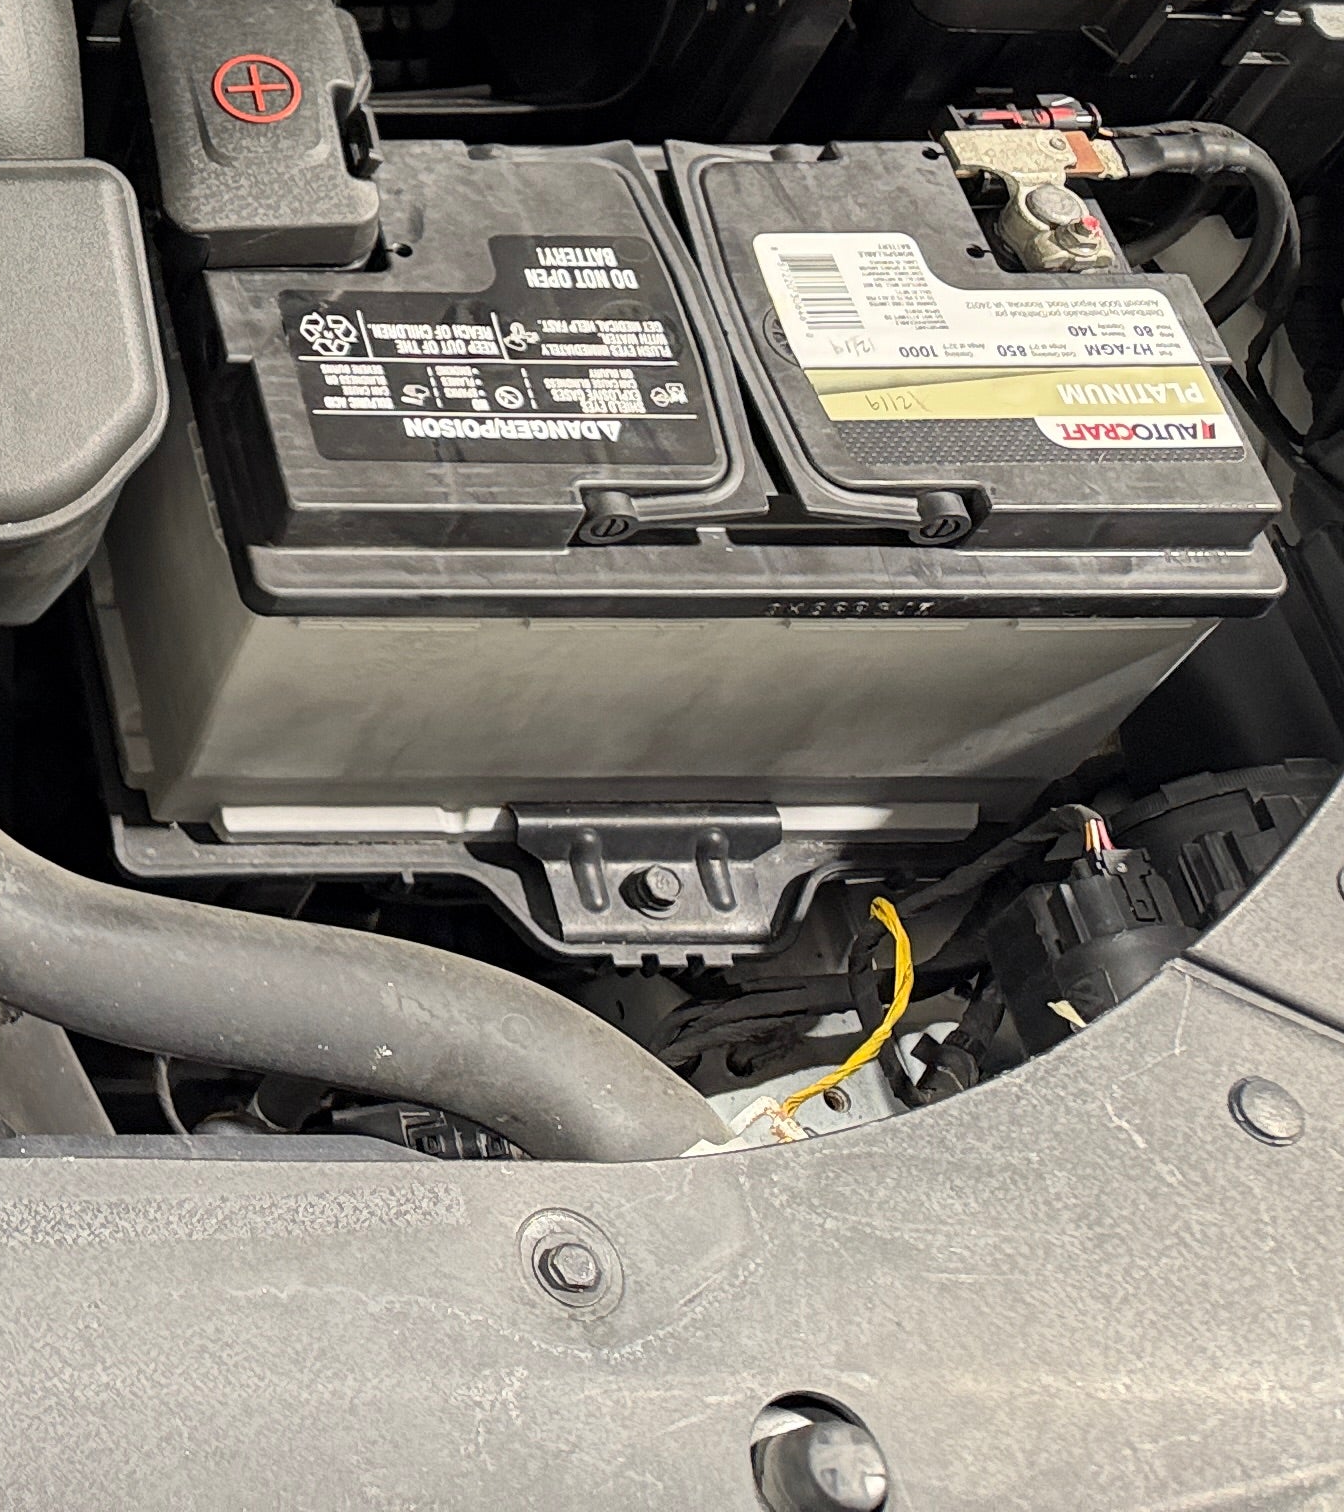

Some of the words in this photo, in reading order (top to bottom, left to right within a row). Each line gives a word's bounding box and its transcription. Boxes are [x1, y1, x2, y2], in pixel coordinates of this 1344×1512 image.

[535, 247, 618, 267] BATTERY!
[524, 268, 572, 289] OPEN
[572, 268, 610, 289] NOT
[609, 268, 638, 289] DO
[366, 323, 433, 340] CHILDREN.
[433, 324, 452, 340] OF
[451, 324, 495, 340] REACH
[536, 319, 567, 333] FAST.
[568, 320, 596, 333] HELP
[595, 320, 642, 333] MEDICAL
[641, 320, 664, 333] GET
[1067, 325, 1097, 337] 140
[1133, 324, 1153, 337] 80
[394, 339, 419, 354] THE
[638, 333, 669, 345] WITH
[421, 340, 439, 354] OF
[439, 340, 467, 355] OUT
[467, 340, 500, 355] KEEP
[609, 344, 636, 357] EYES
[898, 345, 938, 358] 1000
[996, 344, 1027, 357] 850
[1084, 343, 1154, 357] H7-AGM
[1055, 382, 1203, 406] PLATINUM
[402, 418, 601, 440] DANGER/POISON
[1060, 422, 1198, 441] AUTOCRAFT
